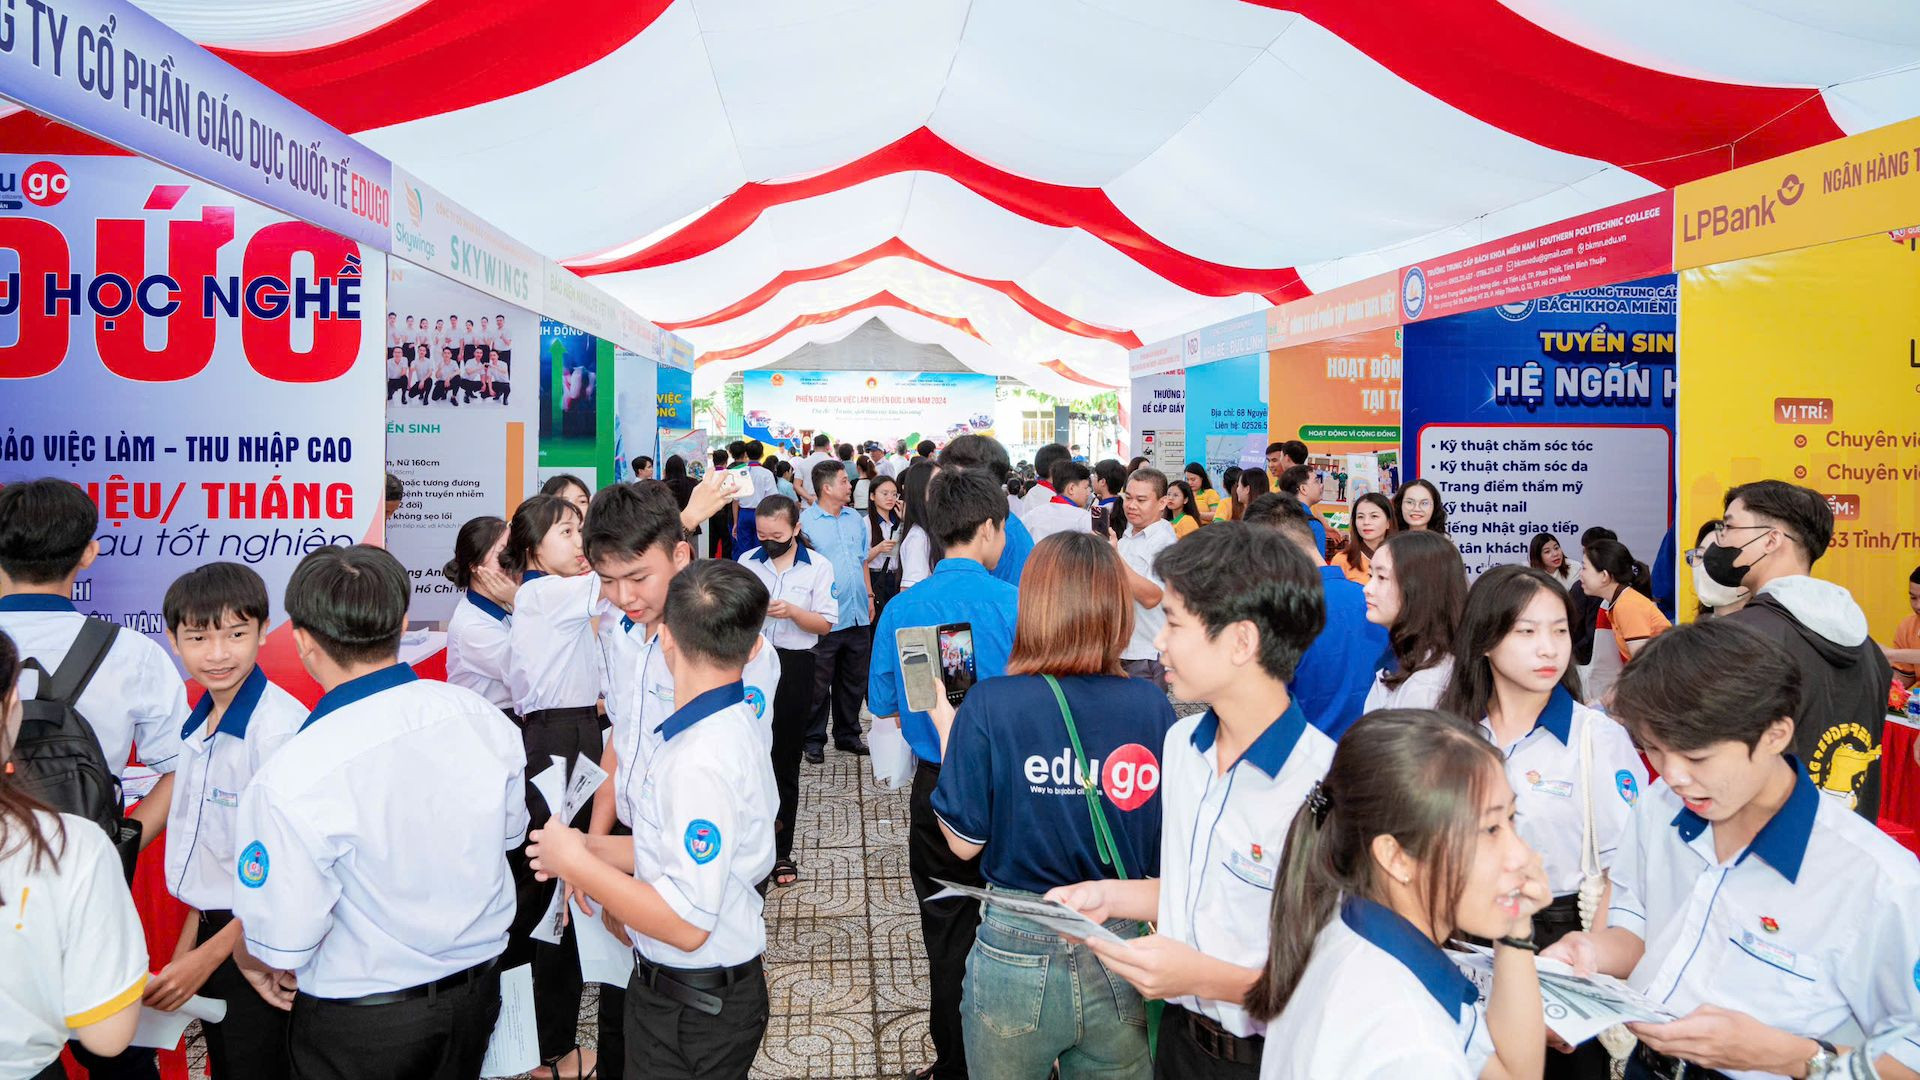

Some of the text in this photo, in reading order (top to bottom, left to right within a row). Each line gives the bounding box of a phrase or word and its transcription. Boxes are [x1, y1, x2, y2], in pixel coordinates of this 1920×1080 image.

[26, 0, 68, 77] TY
[77, 14, 117, 101] CỔ
[124, 48, 190, 138] PHẦN
[197, 90, 244, 162] GIÁO
[250, 118, 284, 185] DỤC
[288, 140, 328, 200] QUỐC
[331, 157, 350, 209] TẾ
[351, 172, 390, 228] EDUGO
[1823, 151, 1909, 194] NGÂN HÀNG
[1540, 230, 1574, 246] SOUTHERN
[1575, 217, 1624, 237] POLYTECHNIC
[1625, 207, 1661, 224] COLLEGE
[1683, 195, 1776, 243] LPBank
[396, 222, 435, 260] Skywings
[450, 235, 529, 301] SKYWINGS
[45, 272, 182, 330] HỌC
[203, 254, 362, 320] NGHỀ
[1616, 287, 1653, 297] TRUNG
[1539, 295, 1668, 313] BÁCH KHOA MIỀN
[1539, 323, 1676, 353] TUYỂN SIN
[1327, 358, 1366, 383] HOẠT
[1497, 361, 1543, 404] HỆ
[1555, 361, 1650, 399] NGẮN
[1169, 401, 1184, 413] GIẤY
[1362, 389, 1385, 414] TẠI
[1781, 401, 1828, 423] VỊ TRÍ:
[408, 423, 440, 434] SINH
[1308, 429, 1327, 438] HOẠT
[1328, 429, 1348, 438] ĐỘNG
[1356, 429, 1376, 438] CỘNG
[1377, 428, 1396, 437] ĐỒNG
[0, 427, 352, 469] ẢO VIỆC LÀM THU NHẬP CAO
[1440, 440, 1593, 454] Kỹ thuật chăm sóc tóc
[1826, 430, 1898, 452] Chuyên
[397, 458, 410, 466] Nữ
[1440, 460, 1588, 474] Kỹ thuật chăm sóc da
[1827, 463, 1899, 485] Chuyên
[202, 475, 354, 520] THÁNG
[1440, 479, 1583, 495] Trang điểm thẩm mỹ
[405, 501, 423, 509] đời)
[1441, 501, 1527, 515] Kỹ thuật nail
[393, 512, 422, 521] không
[1444, 520, 1579, 535] iếng Nhật giao tiếp
[156, 524, 210, 556] tốt
[1459, 542, 1528, 553] tân khách
[415, 583, 431, 593] Hồ
[1030, 785, 1045, 794] Way
